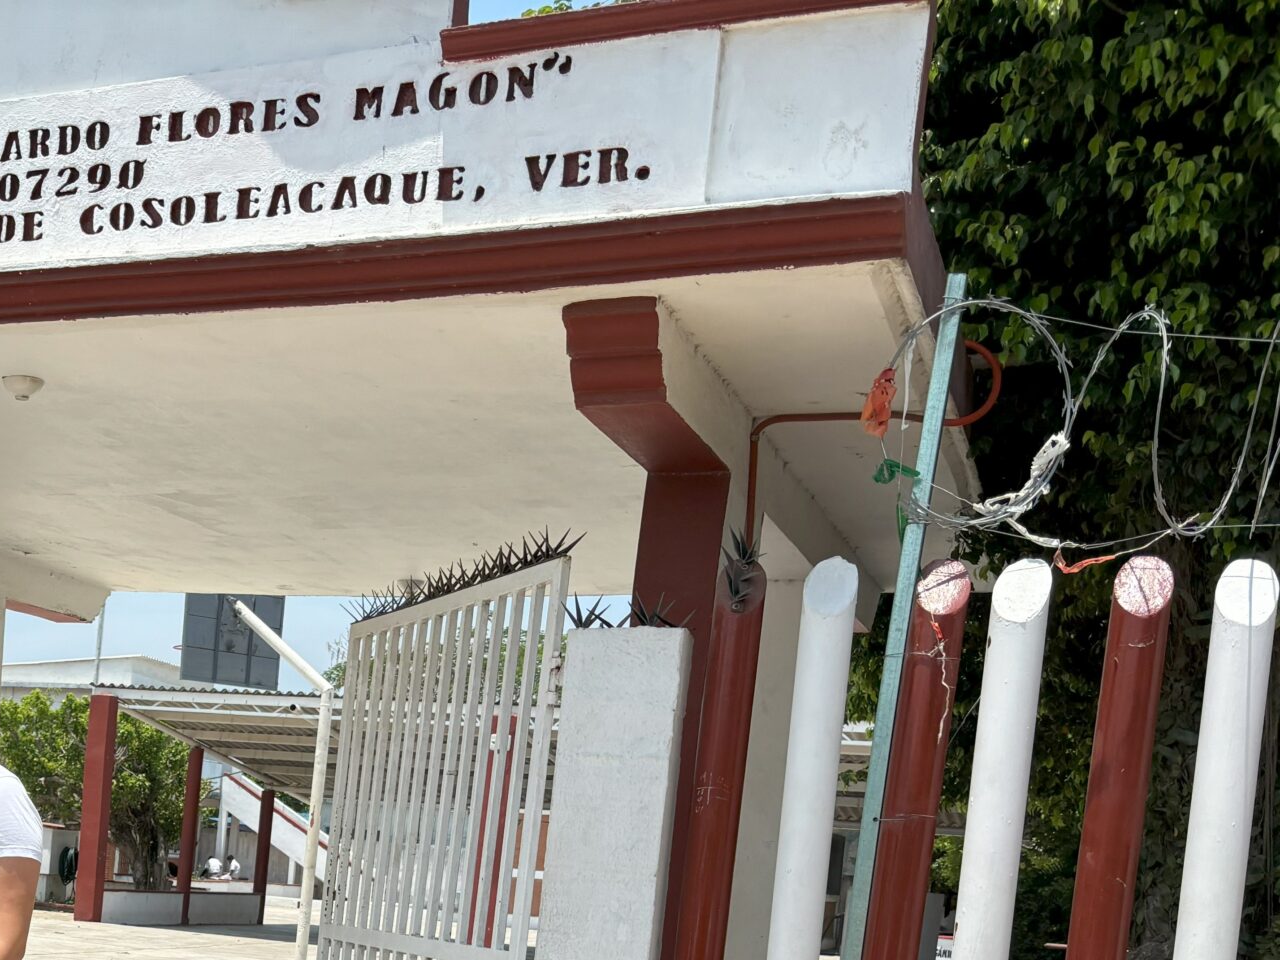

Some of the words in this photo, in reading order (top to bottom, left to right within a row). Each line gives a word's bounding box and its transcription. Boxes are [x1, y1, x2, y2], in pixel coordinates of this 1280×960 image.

[136, 93, 321, 146] FLORES
[79, 166, 485, 235] COSOLEACAQUE,
[524, 147, 651, 192] VER.
